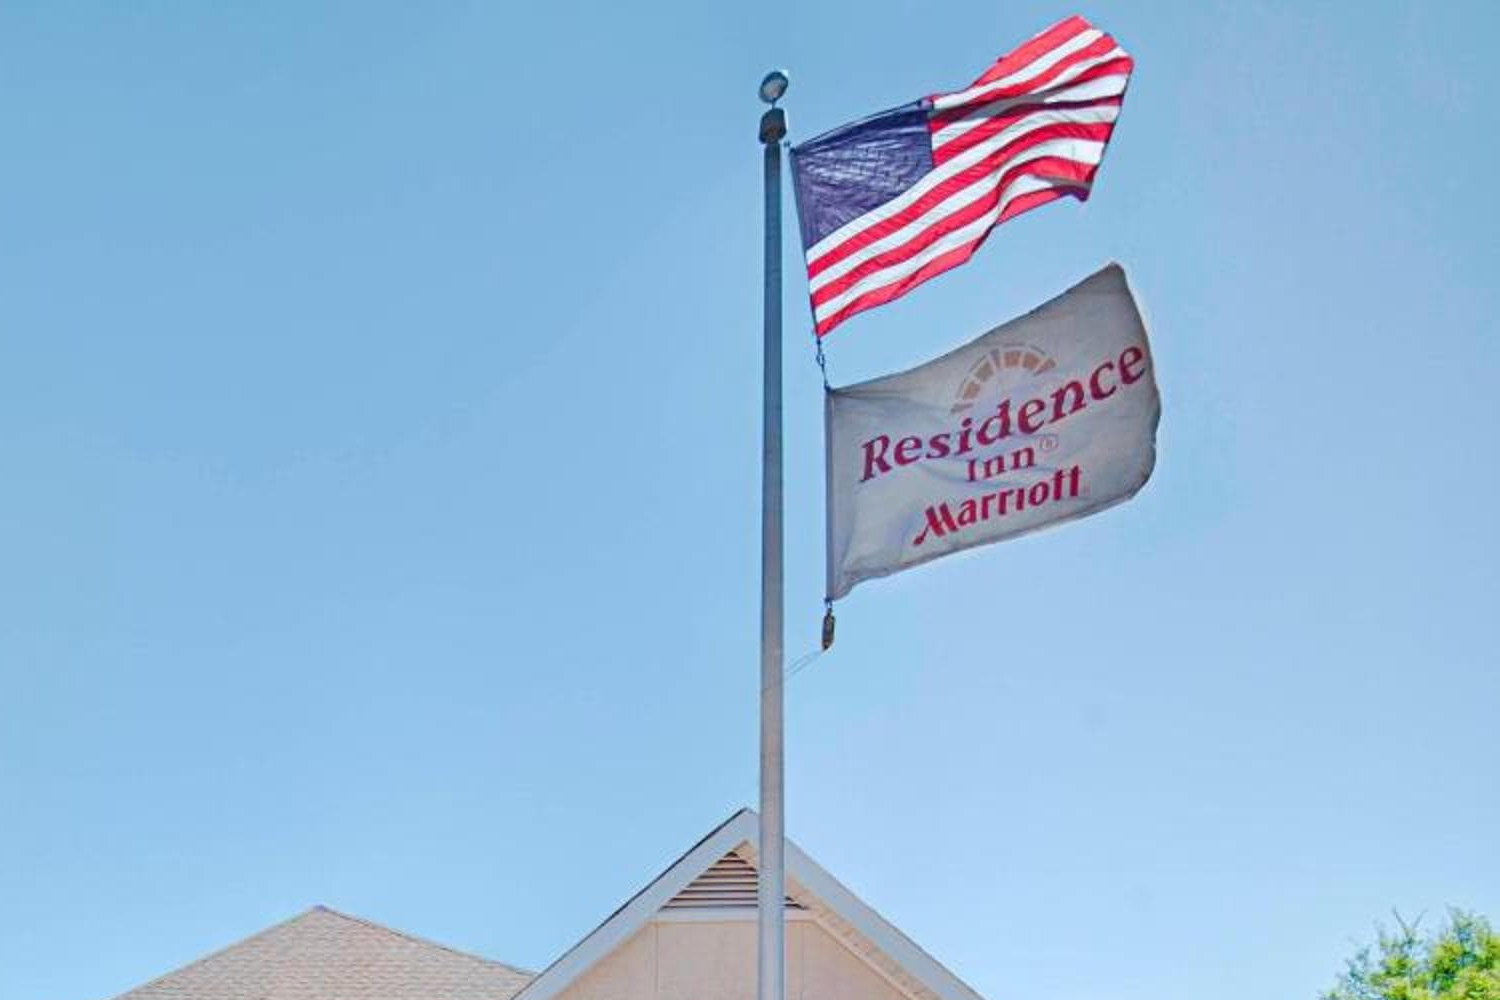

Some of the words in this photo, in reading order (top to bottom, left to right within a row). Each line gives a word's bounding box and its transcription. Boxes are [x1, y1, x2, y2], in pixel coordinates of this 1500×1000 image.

[859, 345, 1146, 484] Residence
[912, 464, 1082, 546] Marriott
[964, 447, 1037, 483] Inn
